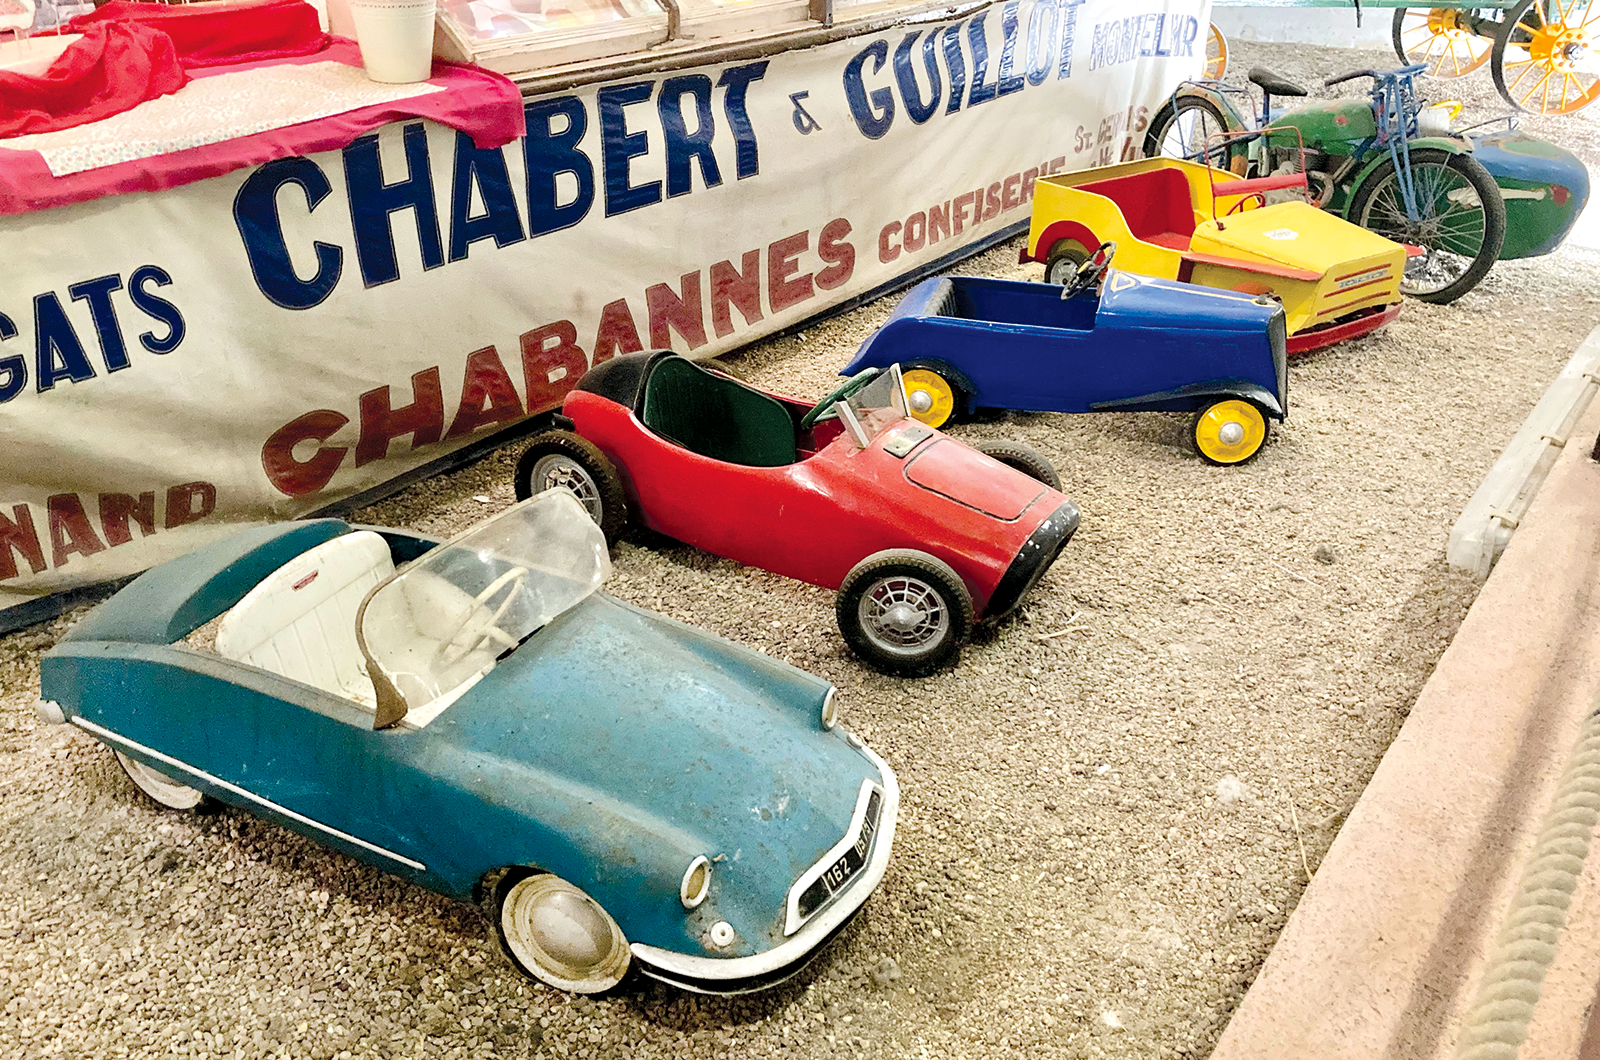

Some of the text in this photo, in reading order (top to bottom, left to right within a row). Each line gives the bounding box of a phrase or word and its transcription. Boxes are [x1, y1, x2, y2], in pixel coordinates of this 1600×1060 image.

[232, 60, 770, 311] CHABERT
[788, 89, 823, 136] &
[843, 0, 1086, 141] GUILLOT
[0, 480, 217, 581] NAND
[261, 217, 856, 497] CHABANNES
[826, 856, 851, 887] 162
